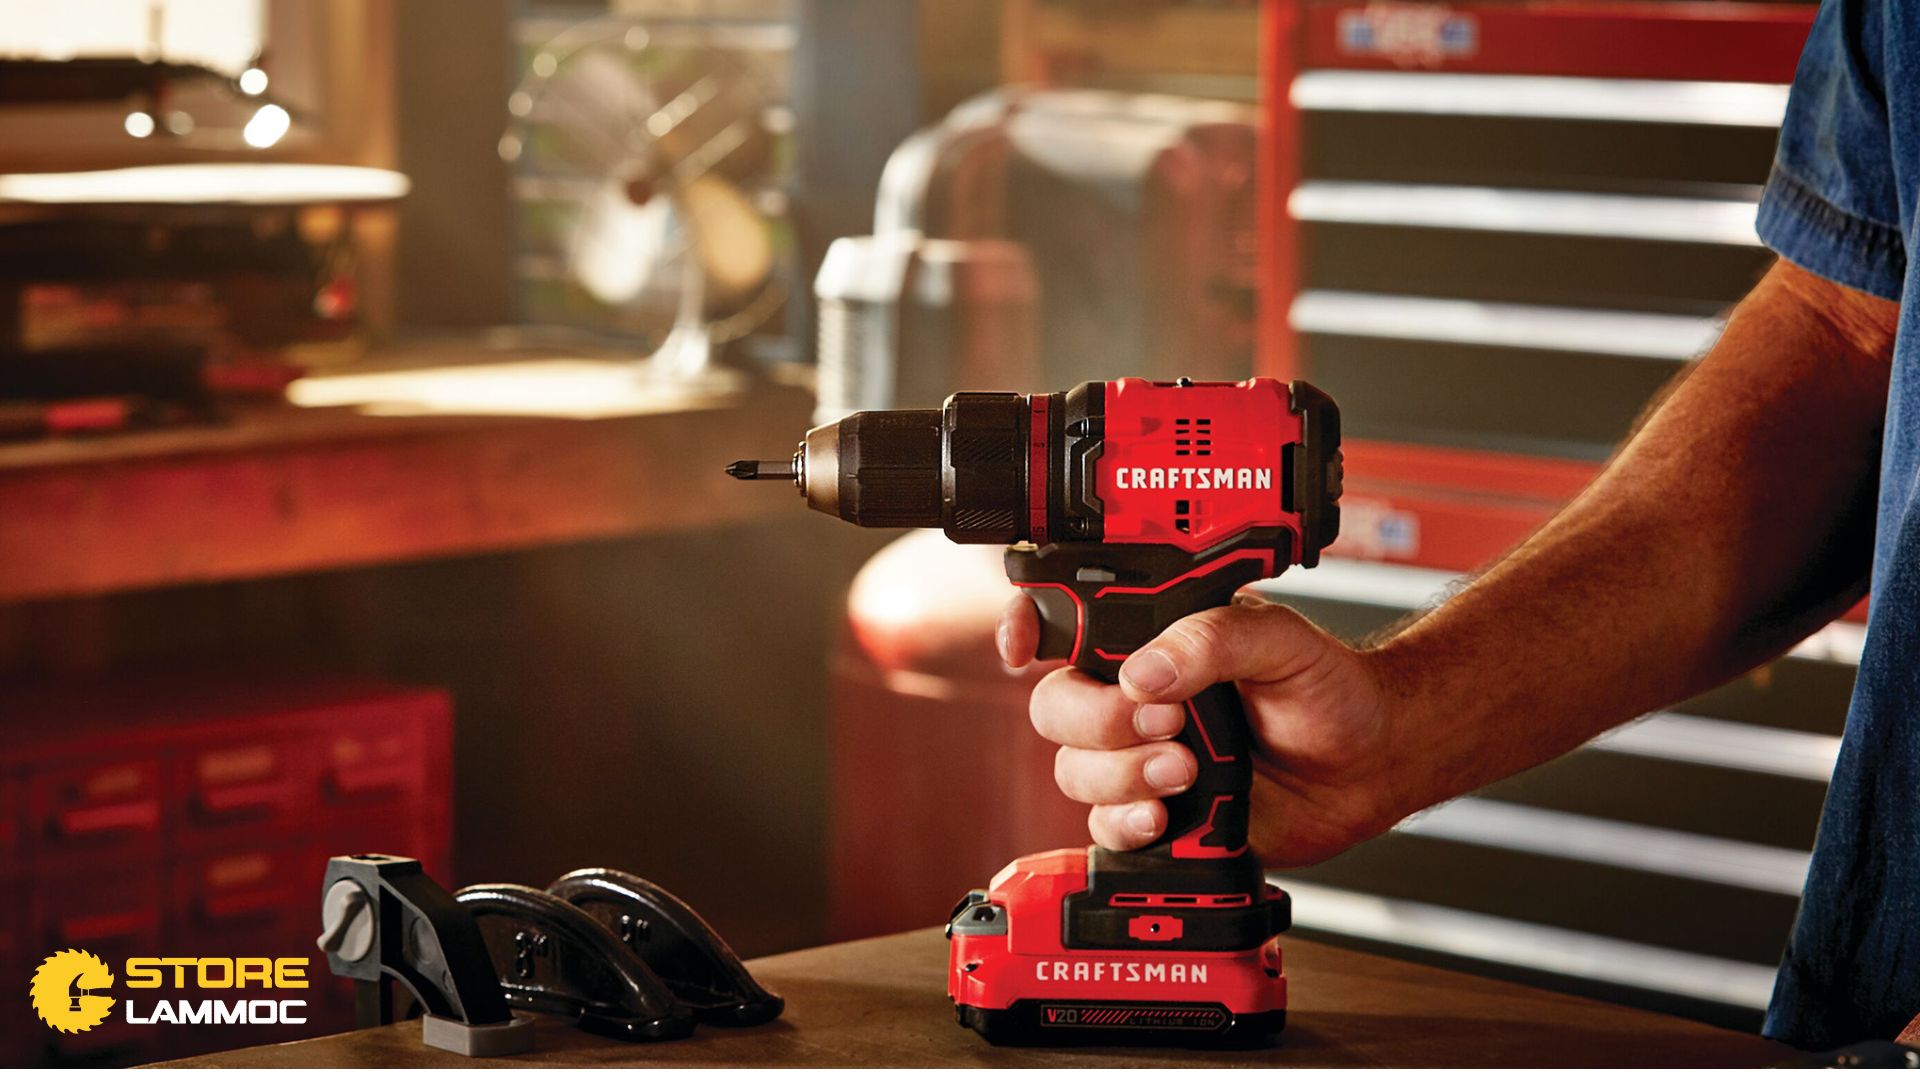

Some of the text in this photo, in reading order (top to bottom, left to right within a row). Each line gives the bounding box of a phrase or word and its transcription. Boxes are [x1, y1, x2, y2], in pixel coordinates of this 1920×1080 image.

[1116, 467, 1271, 490] CRAFTSMAN
[1036, 961, 1208, 984] CRAFTSMAN
[1047, 1009, 1078, 1023] V20
